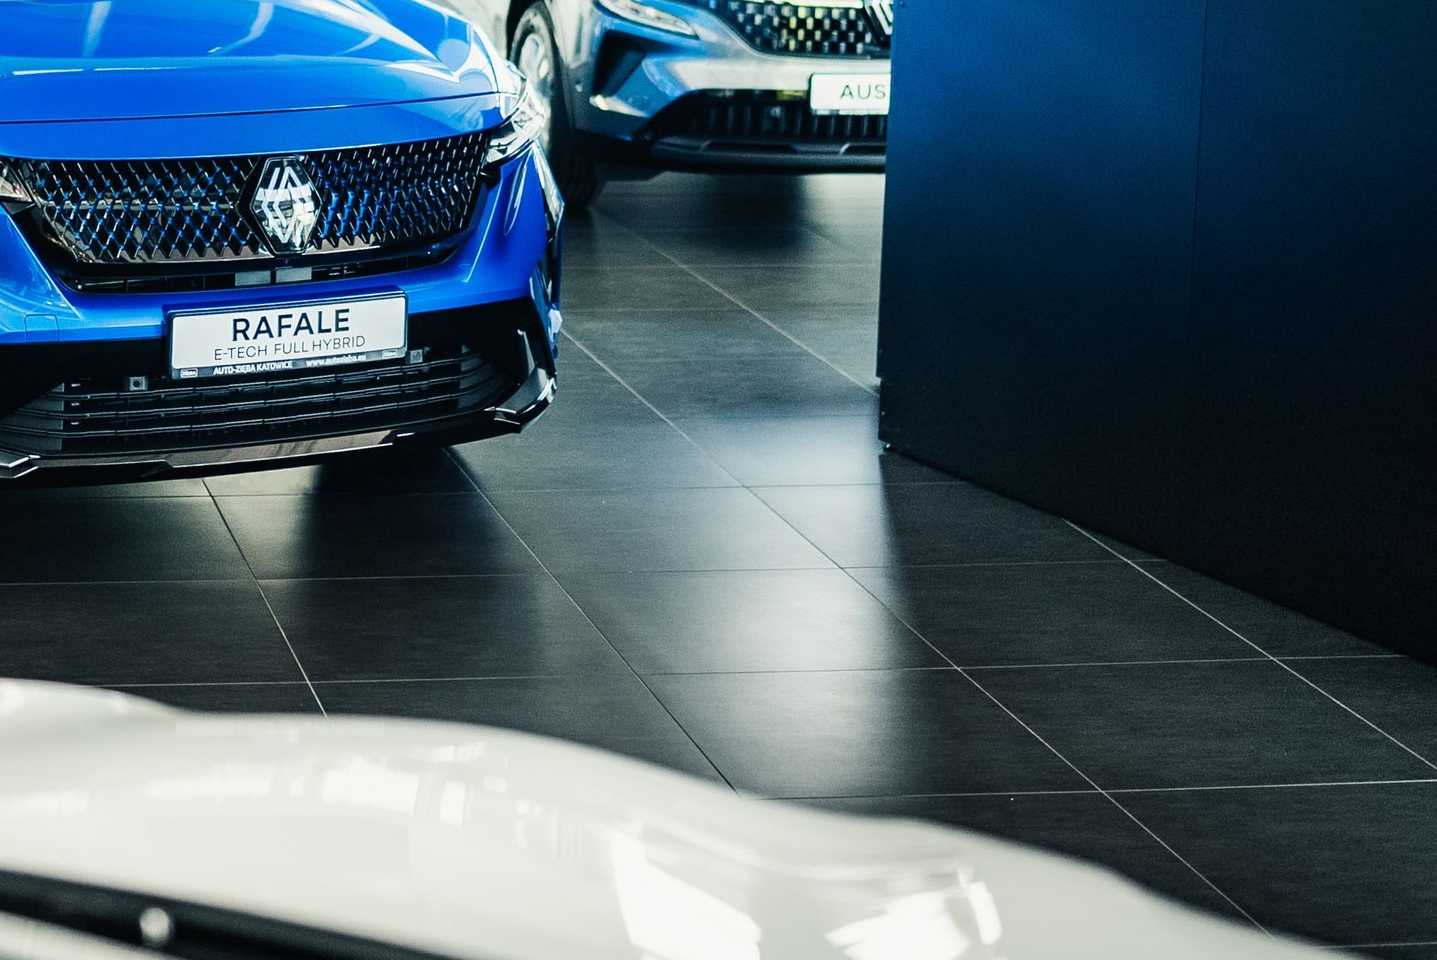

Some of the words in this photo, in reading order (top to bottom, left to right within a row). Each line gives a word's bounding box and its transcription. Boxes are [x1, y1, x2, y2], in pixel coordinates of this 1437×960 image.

[232, 308, 350, 342] RAFALE
[214, 345, 268, 360] E-TECH
[274, 340, 308, 355] FULL
[312, 335, 366, 352] HYBRID
[256, 360, 293, 372] KATOWICE
